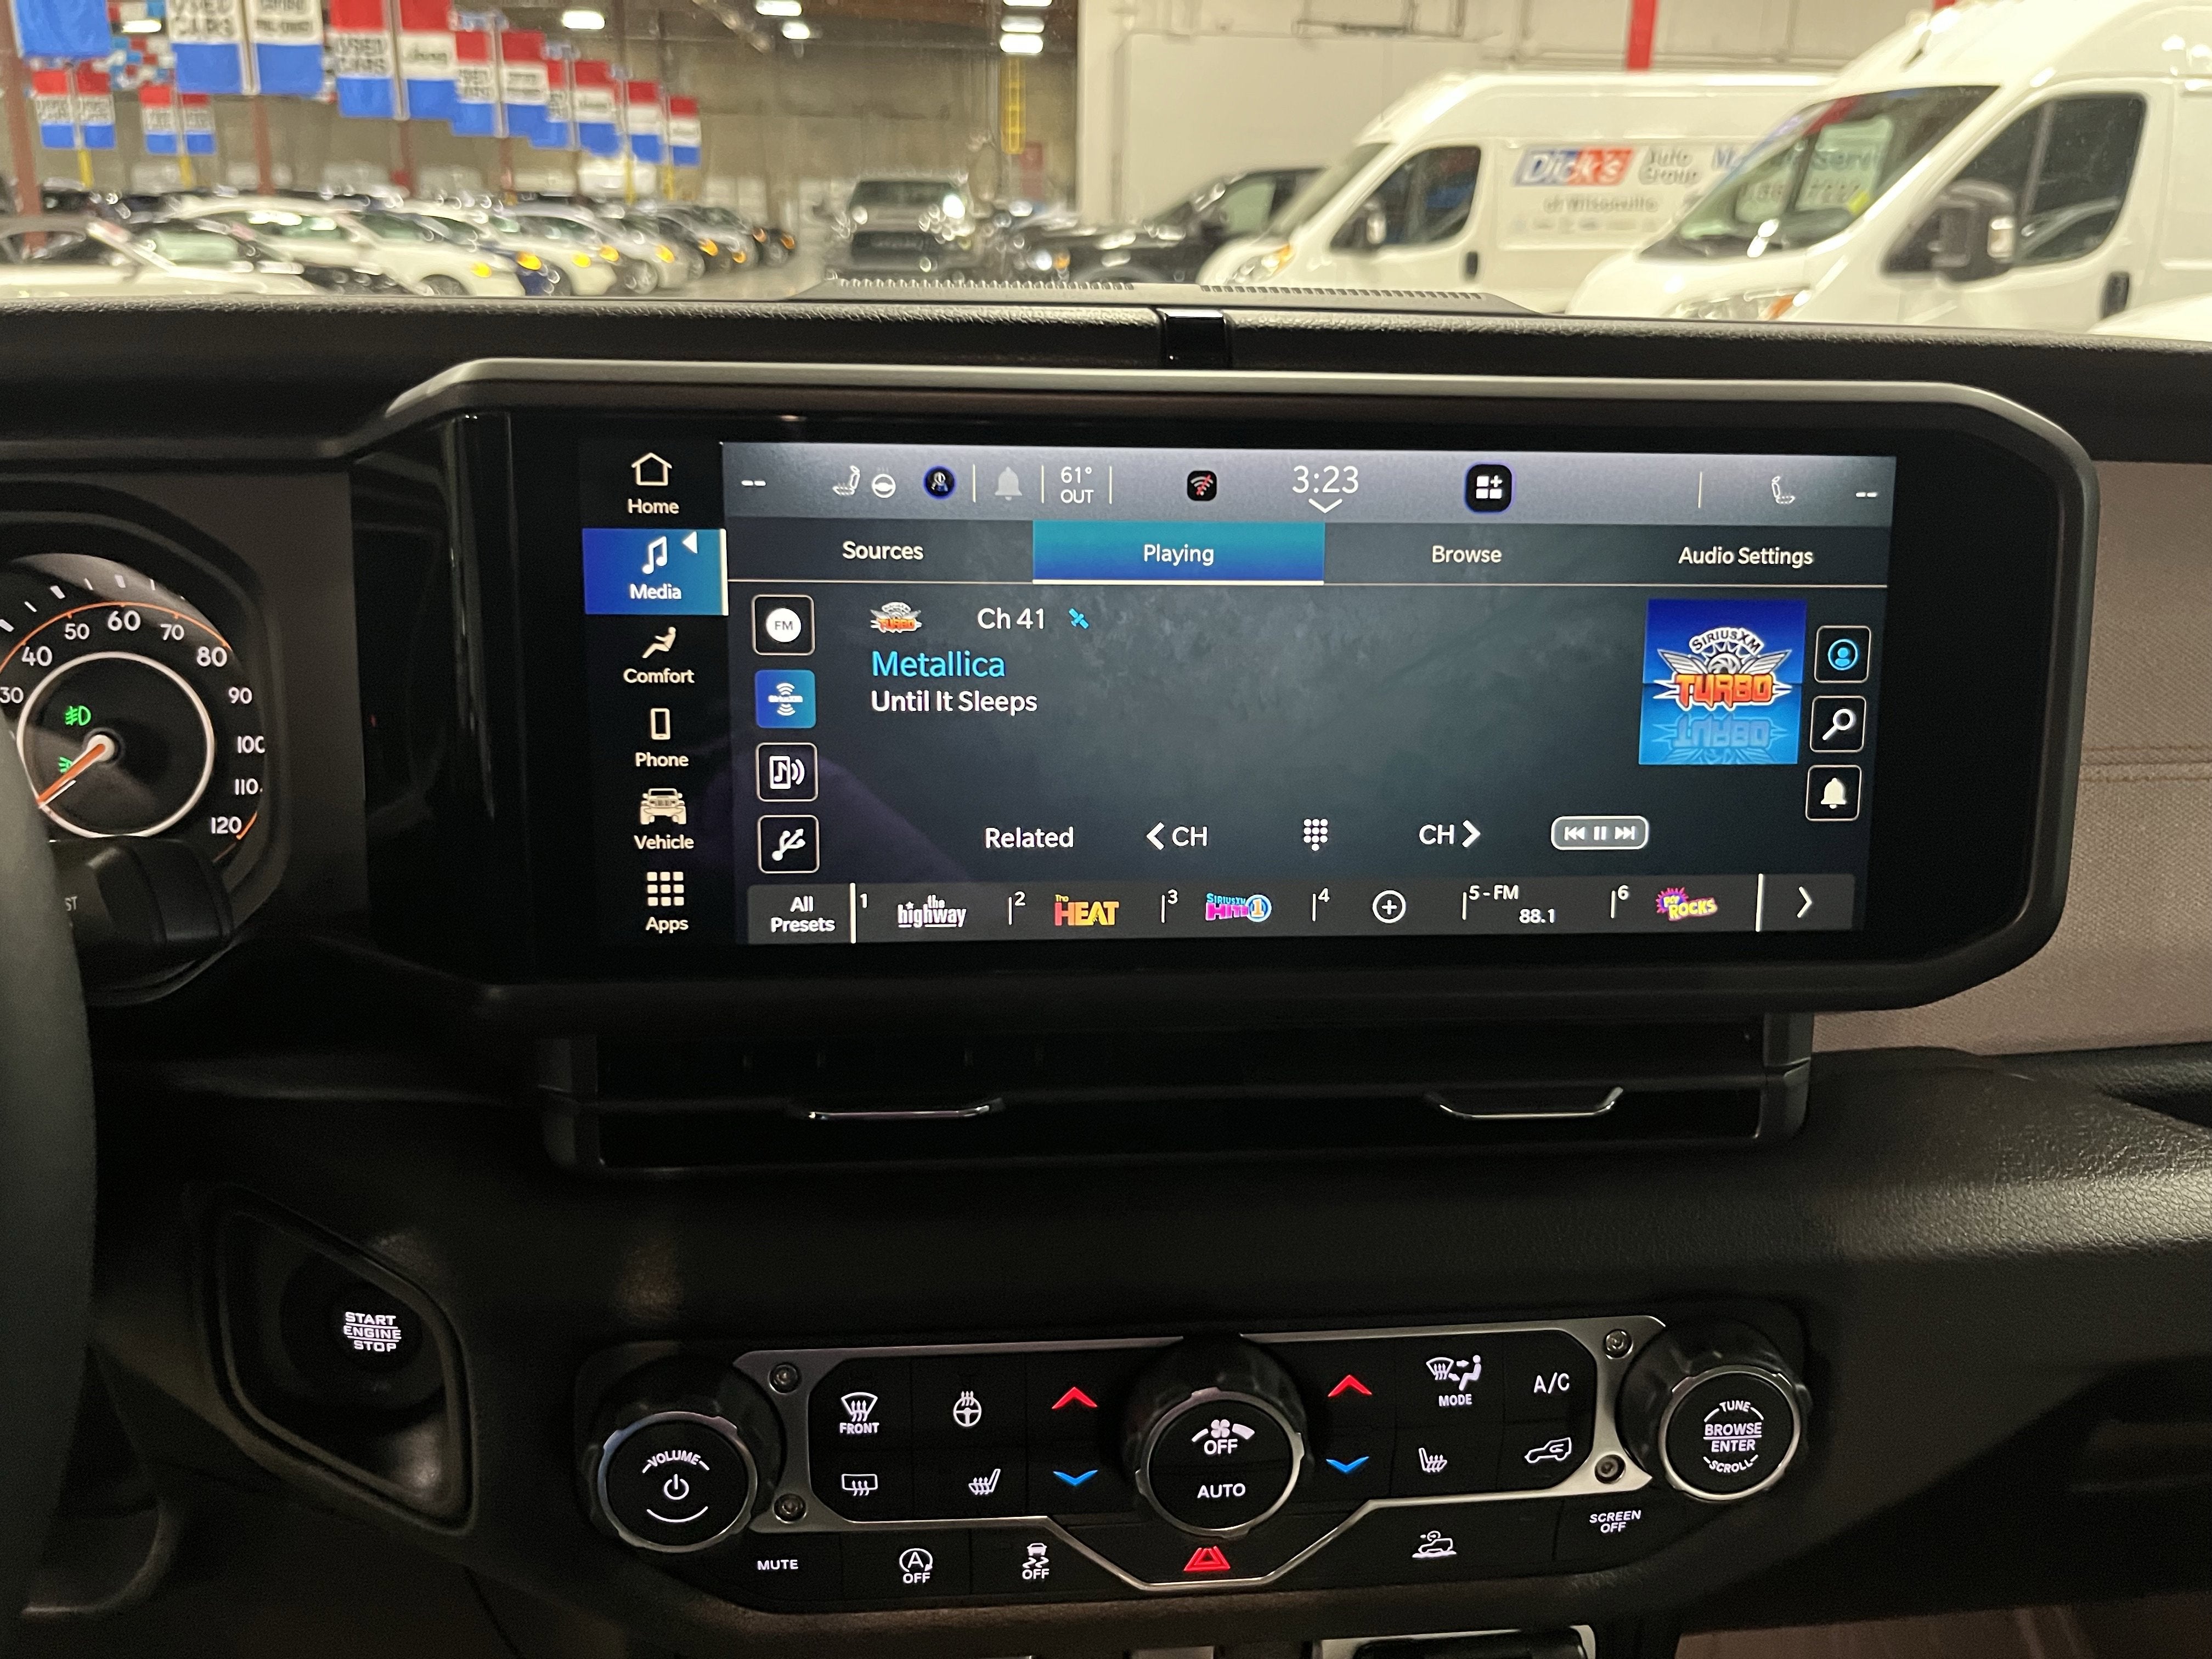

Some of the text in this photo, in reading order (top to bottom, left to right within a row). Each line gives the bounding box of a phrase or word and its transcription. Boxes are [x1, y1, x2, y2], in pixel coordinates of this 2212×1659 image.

[1060, 466, 1092, 484] 61°
[1292, 465, 1359, 494] 3:23
[1060, 489, 1094, 504] OUT
[628, 498, 680, 515] Home
[842, 540, 924, 560] Sources
[1144, 544, 1214, 566] Playing
[1432, 545, 1502, 563] Browse
[1678, 546, 1813, 569] Audio Settings
[629, 583, 682, 600] Media
[107, 610, 141, 631] 60
[774, 620, 794, 631] FM
[977, 607, 1045, 629] Ch 41
[64, 623, 90, 640] 50
[160, 623, 184, 641] 70
[22, 646, 53, 667] 40
[196, 646, 228, 667] 80
[872, 650, 1005, 678] Metallica
[623, 668, 695, 684] Comfort
[0, 686, 24, 703] 30
[228, 687, 252, 704] 90
[1675, 674, 1773, 708] TURBO
[871, 690, 1037, 716] Until It Sleeps
[635, 752, 689, 767] Phone
[235, 778, 259, 795] 110
[211, 816, 242, 834] 120
[634, 834, 695, 850] Vehicle
[985, 826, 1074, 849] Related
[1172, 826, 1207, 847] CH
[1419, 824, 1455, 845] CH
[1014, 891, 1026, 906] 2
[1167, 889, 1178, 905] 3
[1318, 888, 1330, 902] 4
[1617, 884, 1629, 900] 6
[789, 895, 814, 912] All
[859, 893, 868, 909] 1
[927, 894, 945, 909] the
[1668, 898, 1717, 919] ROCKS
[898, 903, 967, 928] highway
[1054, 901, 1120, 926] HEAT
[1519, 909, 1555, 924] 88.1
[645, 916, 689, 934] Apps
[770, 917, 836, 933] Presets
[345, 1311, 396, 1325] START
[343, 1325, 402, 1340] ENGINE
[353, 1340, 396, 1352] STOP
[1533, 1372, 1570, 1394] A/C
[1438, 1393, 1472, 1407] MODE
[1719, 1400, 1751, 1412] TUNE
[839, 1422, 880, 1434] FRONT
[1705, 1422, 1762, 1436] BROWSE
[1204, 1439, 1238, 1455] OFF
[1711, 1439, 1756, 1452] ENTER
[647, 1449, 701, 1467] VOLUME
[1709, 1459, 1753, 1473] SCROLL
[1197, 1483, 1246, 1498] AUTO
[1589, 1510, 1641, 1523] SCREEN
[1600, 1522, 1627, 1533] OFF
[757, 1559, 799, 1571] MUTE
[902, 1572, 930, 1584] OFF
[1022, 1568, 1049, 1580] OFF
